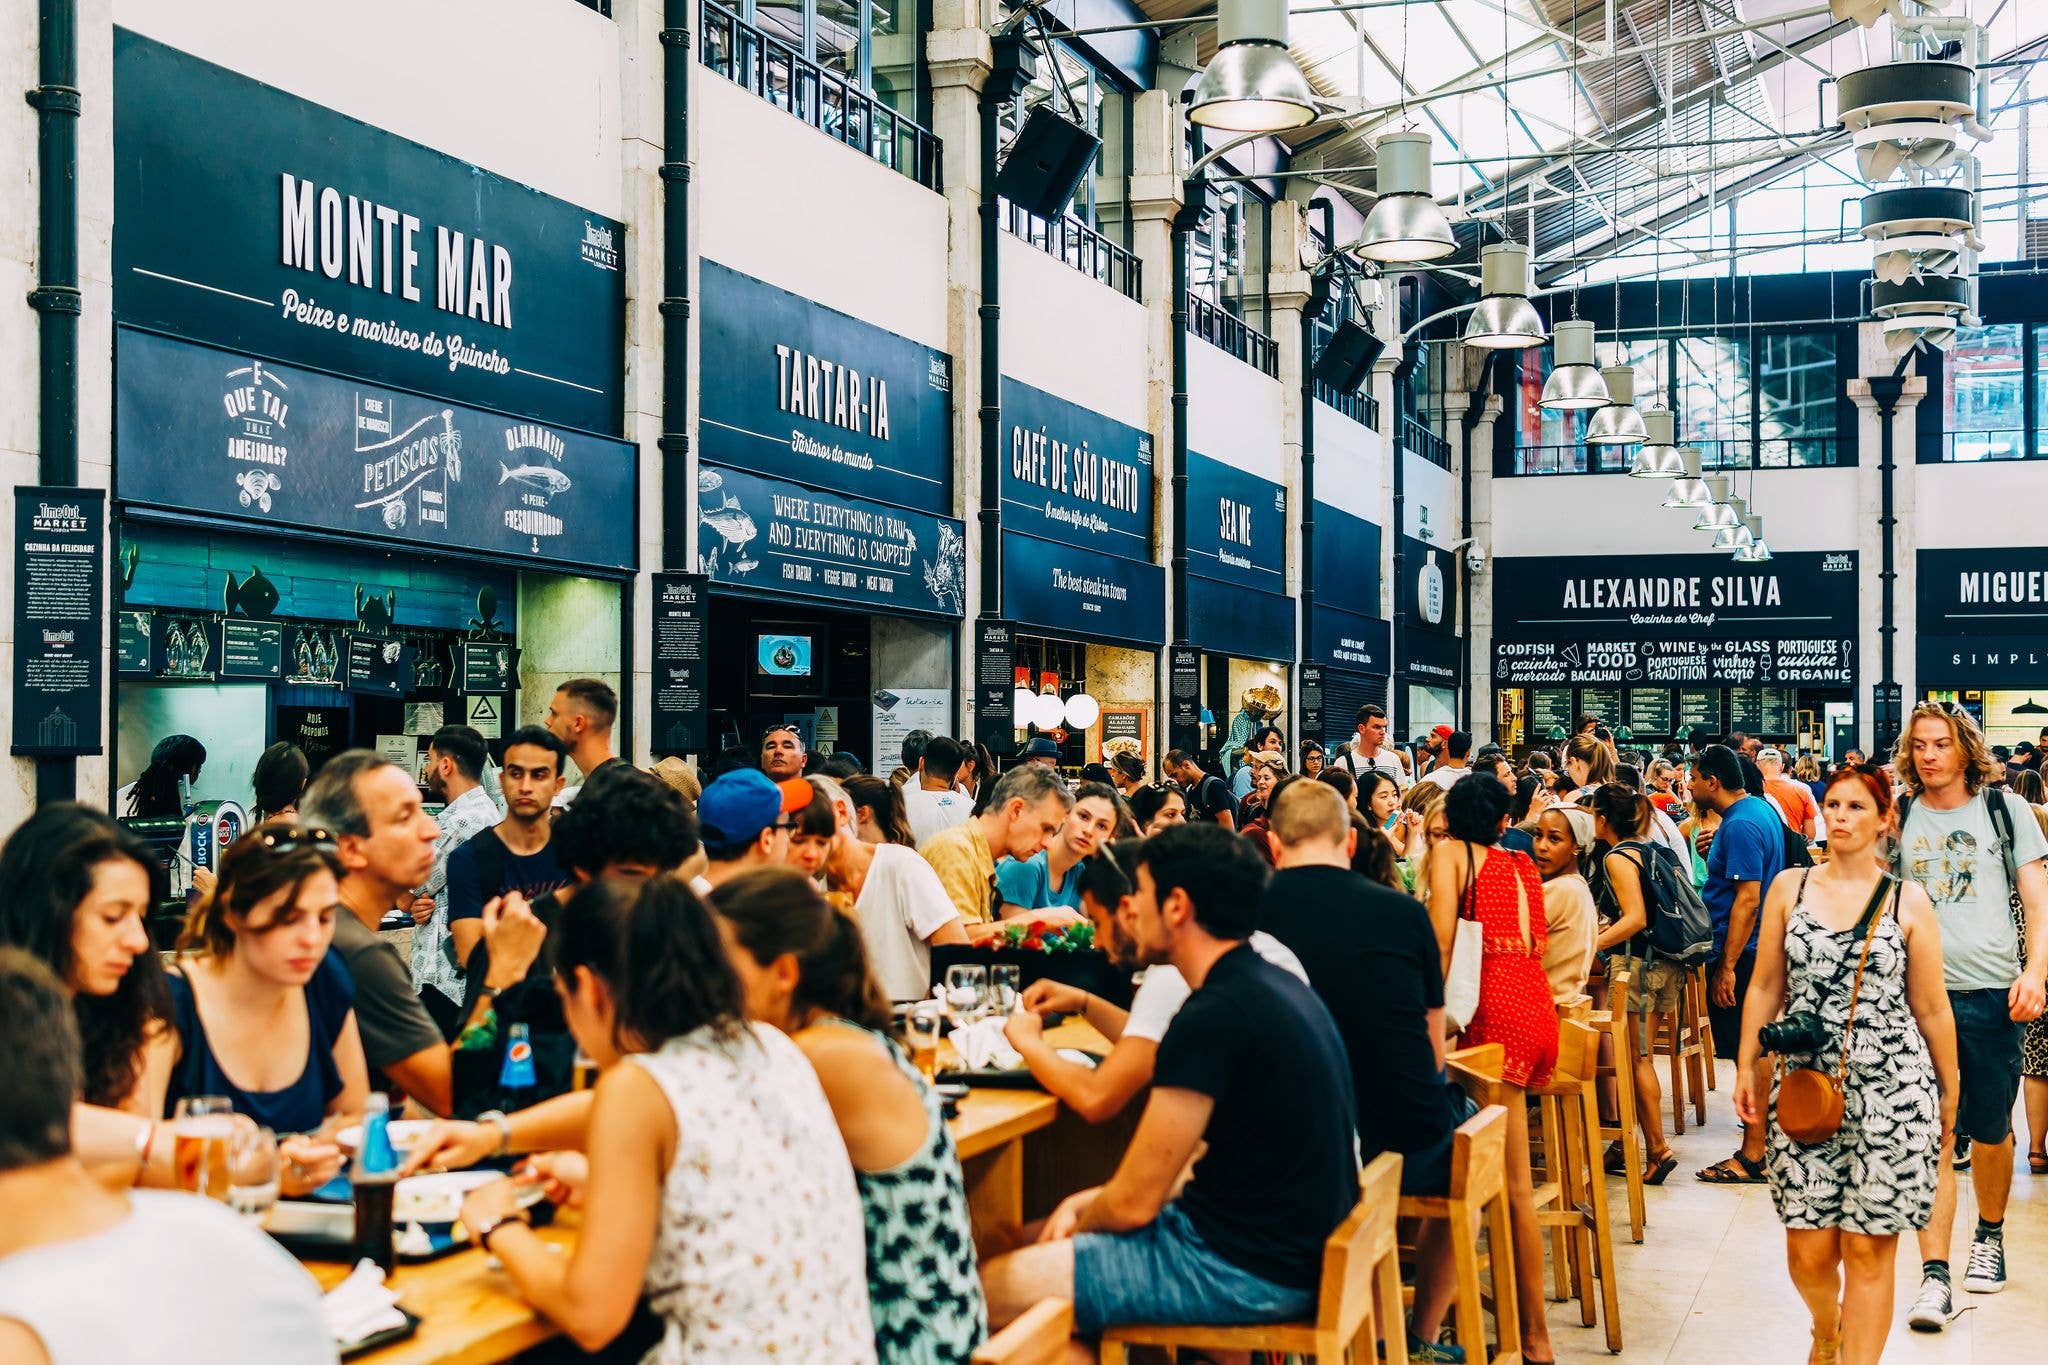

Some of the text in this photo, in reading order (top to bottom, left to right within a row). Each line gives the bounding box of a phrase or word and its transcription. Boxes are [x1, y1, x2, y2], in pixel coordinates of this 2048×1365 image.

[282, 172, 512, 329] MONTE MAR
[582, 244, 617, 266] MARKET
[282, 288, 511, 375] Peixe e marisco do Guincho
[254, 360, 262, 386] E
[776, 344, 889, 440] TARTAR-IA
[223, 387, 288, 429] QUE TAL
[364, 435, 439, 493] PETISCOS
[832, 444, 844, 463] do
[844, 452, 873, 471] mundo
[1013, 425, 1139, 514] CAFÉ DE SÃO BENTO
[39, 503, 80, 520] Time Out
[773, 494, 906, 540] WHERE EVERYTHING IS RAW
[1045, 500, 1051, 518] O
[33, 519, 86, 528] MARKET
[1220, 496, 1237, 542] SEA
[1239, 503, 1251, 547] ME
[24, 543, 95, 553] COZINHA DA FELICIDADE
[768, 522, 911, 567] AND EVERYTHING IS CHOPPED
[782, 562, 794, 580] FISH
[1052, 567, 1127, 601] The best steak in town
[1563, 576, 1781, 609] ALEXANDRE SILVA
[1630, 612, 1716, 627] Cozinha de Chef
[1498, 643, 1555, 655] CODFISH
[1587, 642, 1637, 653] MARKET
[1658, 640, 1770, 655] WINE by the GLASS
[1777, 639, 1837, 654] PORTUGUESE
[1511, 656, 1559, 670] cozinha
[1587, 653, 1637, 668] FOOD
[1647, 655, 1706, 670] PORTUGUESE
[1712, 654, 1756, 669] vinhos
[1777, 655, 1838, 667] cuisine
[1952, 653, 2048, 665] SIMPL
[1511, 668, 1567, 682] mercado
[1571, 670, 1622, 682] BACALHAU
[1647, 665, 1707, 681] TRADITION
[1723, 669, 1755, 683] copo
[1777, 669, 1851, 681] ORGANIC
[197, 831, 207, 864] BOCK
